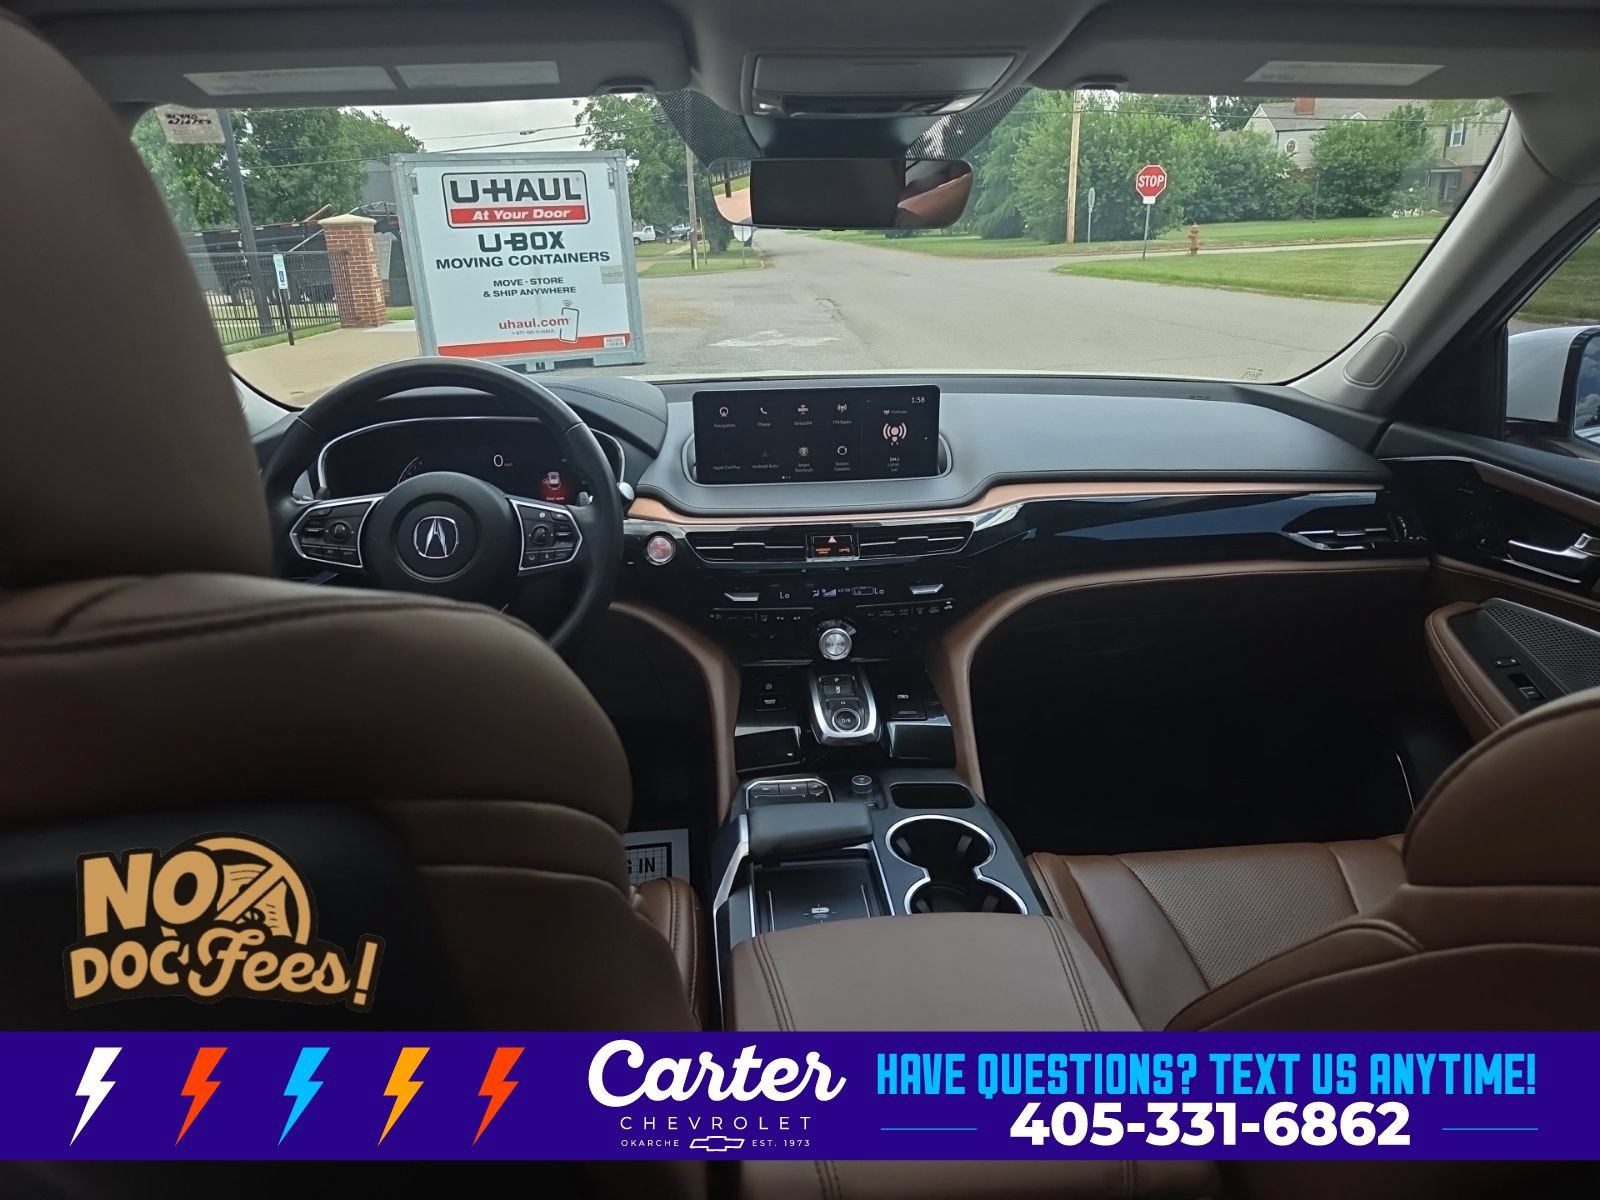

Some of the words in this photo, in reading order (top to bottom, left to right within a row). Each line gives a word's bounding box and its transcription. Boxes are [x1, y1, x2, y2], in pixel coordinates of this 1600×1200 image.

[1138, 175, 1164, 188] STOP
[450, 177, 582, 203] U-HAUL
[472, 208, 490, 221] At
[493, 209, 529, 220] Your
[533, 208, 571, 220] Door
[478, 231, 566, 252] U-BOX
[436, 256, 504, 270] MOVING
[508, 251, 611, 267] CONTAINERS
[493, 279, 524, 287] MOVE
[529, 276, 564, 286] STORE
[483, 290, 491, 298] &
[492, 289, 518, 298] SHIP
[519, 286, 577, 297] ANYWHERE
[498, 317, 569, 330] uhaul.com
[493, 454, 504, 468] 0
[639, 857, 656, 874] IN
